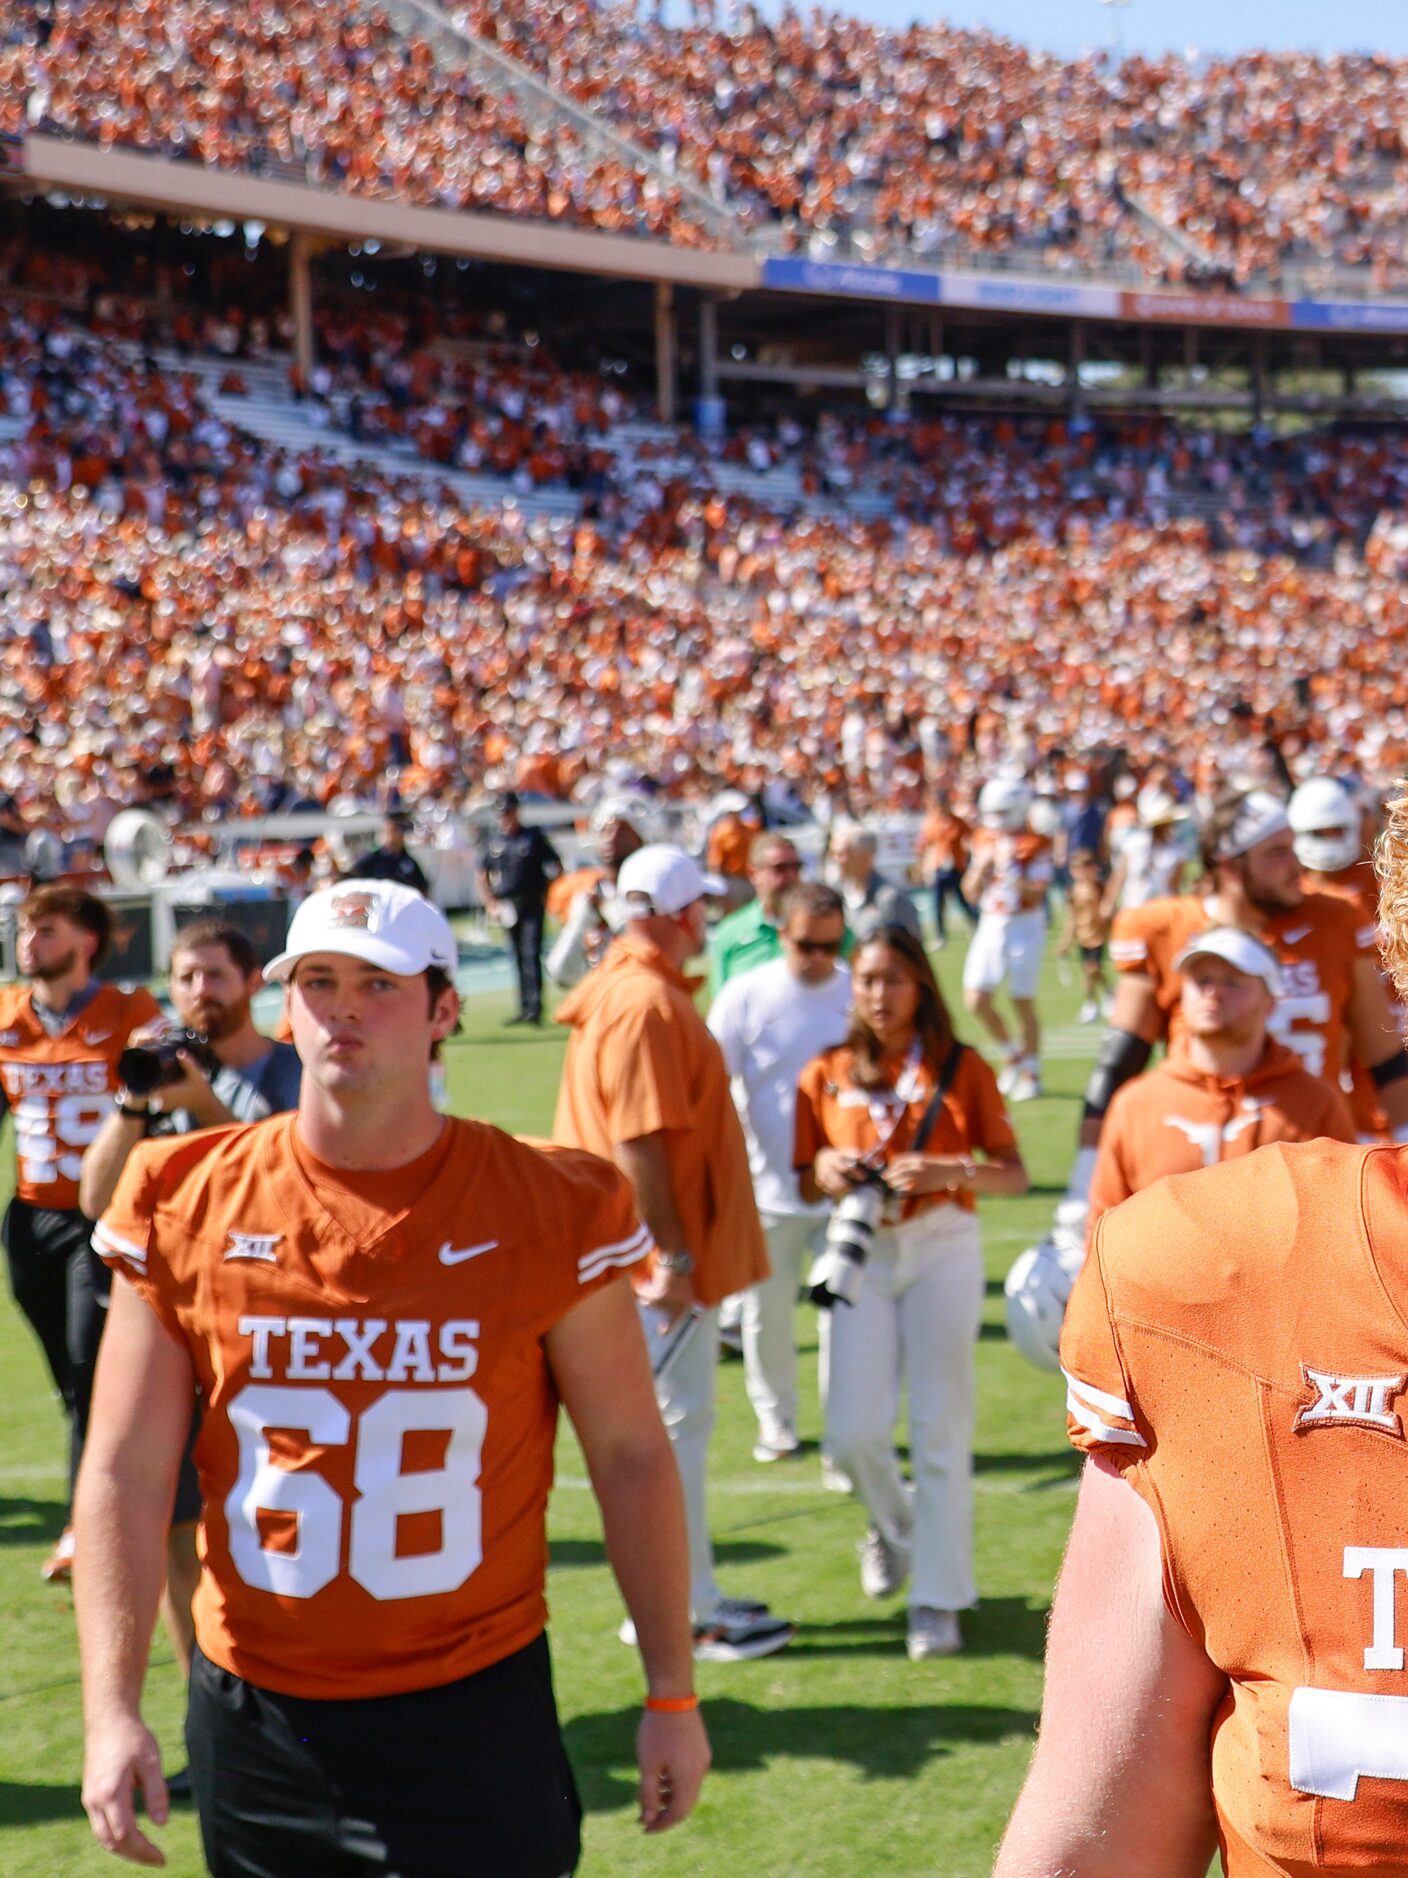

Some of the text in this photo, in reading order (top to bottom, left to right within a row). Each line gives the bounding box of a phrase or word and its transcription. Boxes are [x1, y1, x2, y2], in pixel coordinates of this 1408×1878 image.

[3, 1062, 109, 1095] TEXAS
[238, 1316, 480, 1382] TEXAS
[1299, 1368, 1402, 1428] XII
[224, 1384, 488, 1600] 68
